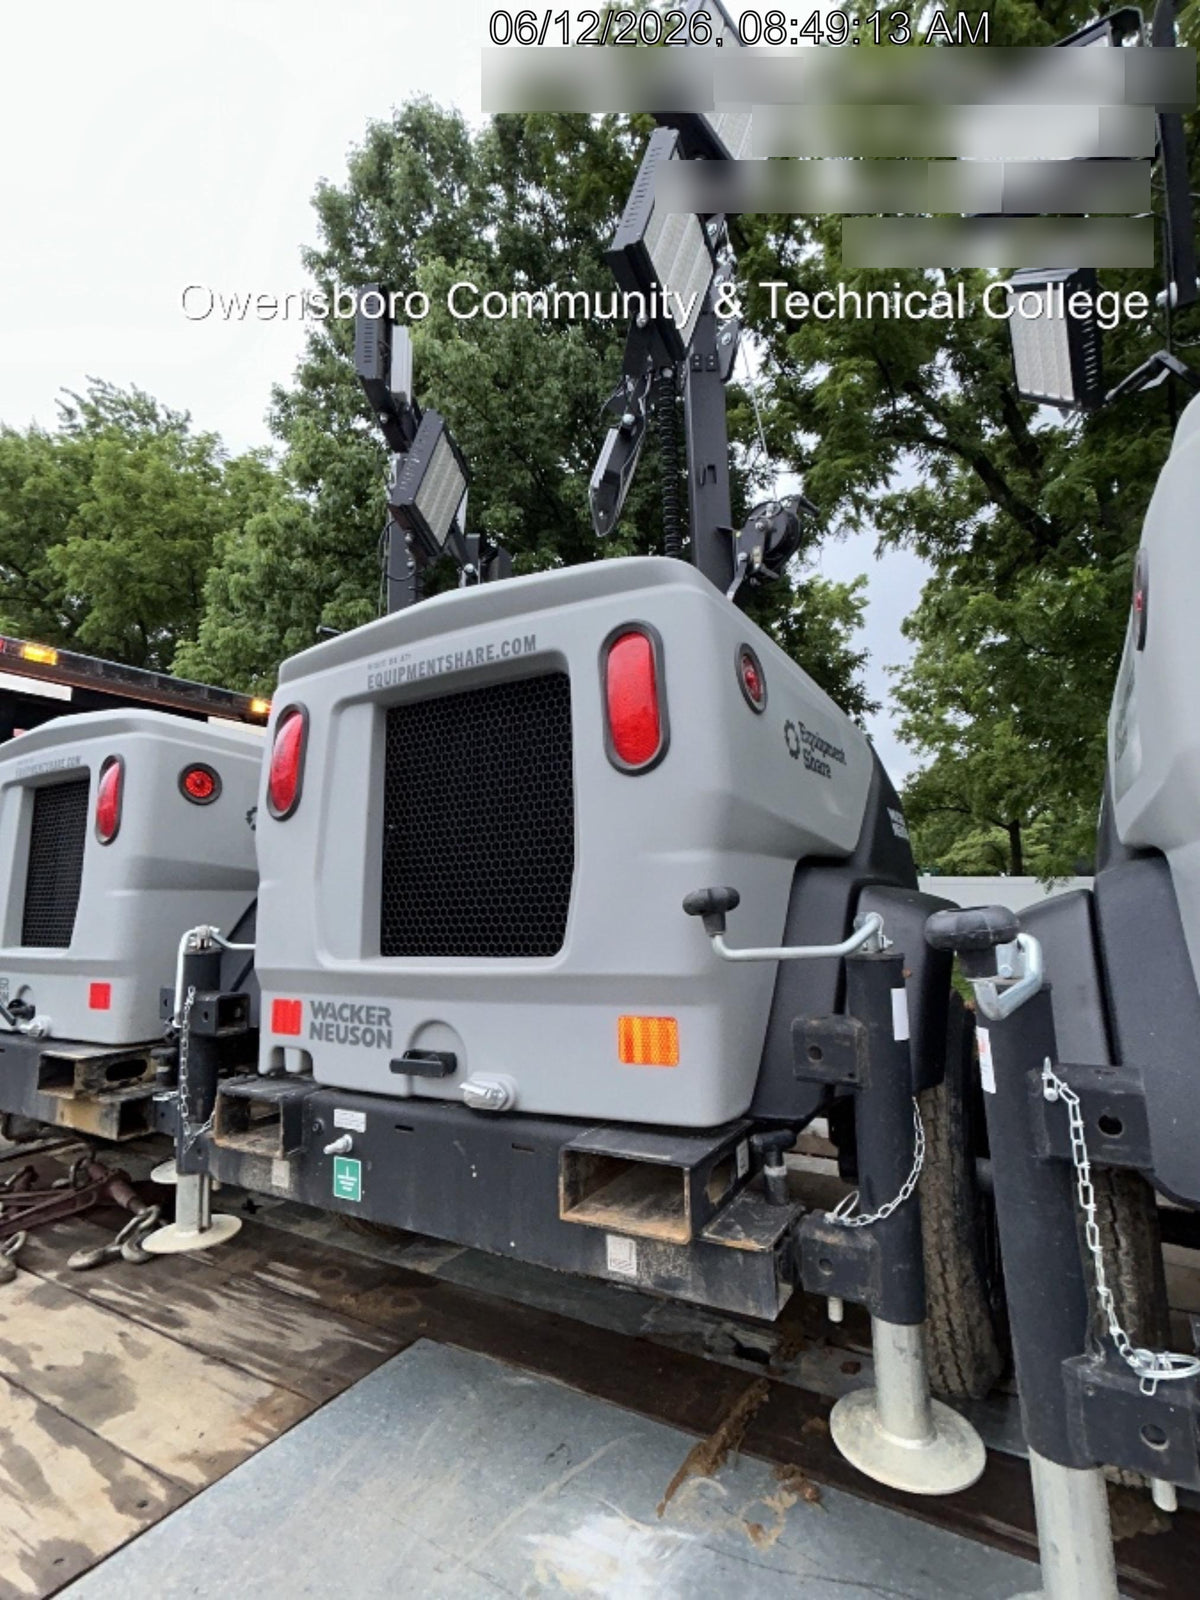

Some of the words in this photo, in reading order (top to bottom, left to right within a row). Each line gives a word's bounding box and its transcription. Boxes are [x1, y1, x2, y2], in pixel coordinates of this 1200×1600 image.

[367, 634, 537, 690] EQUIPMENTSHARE.COM
[308, 1000, 392, 1028] WACKER
[308, 1021, 392, 1049] NEUSON
